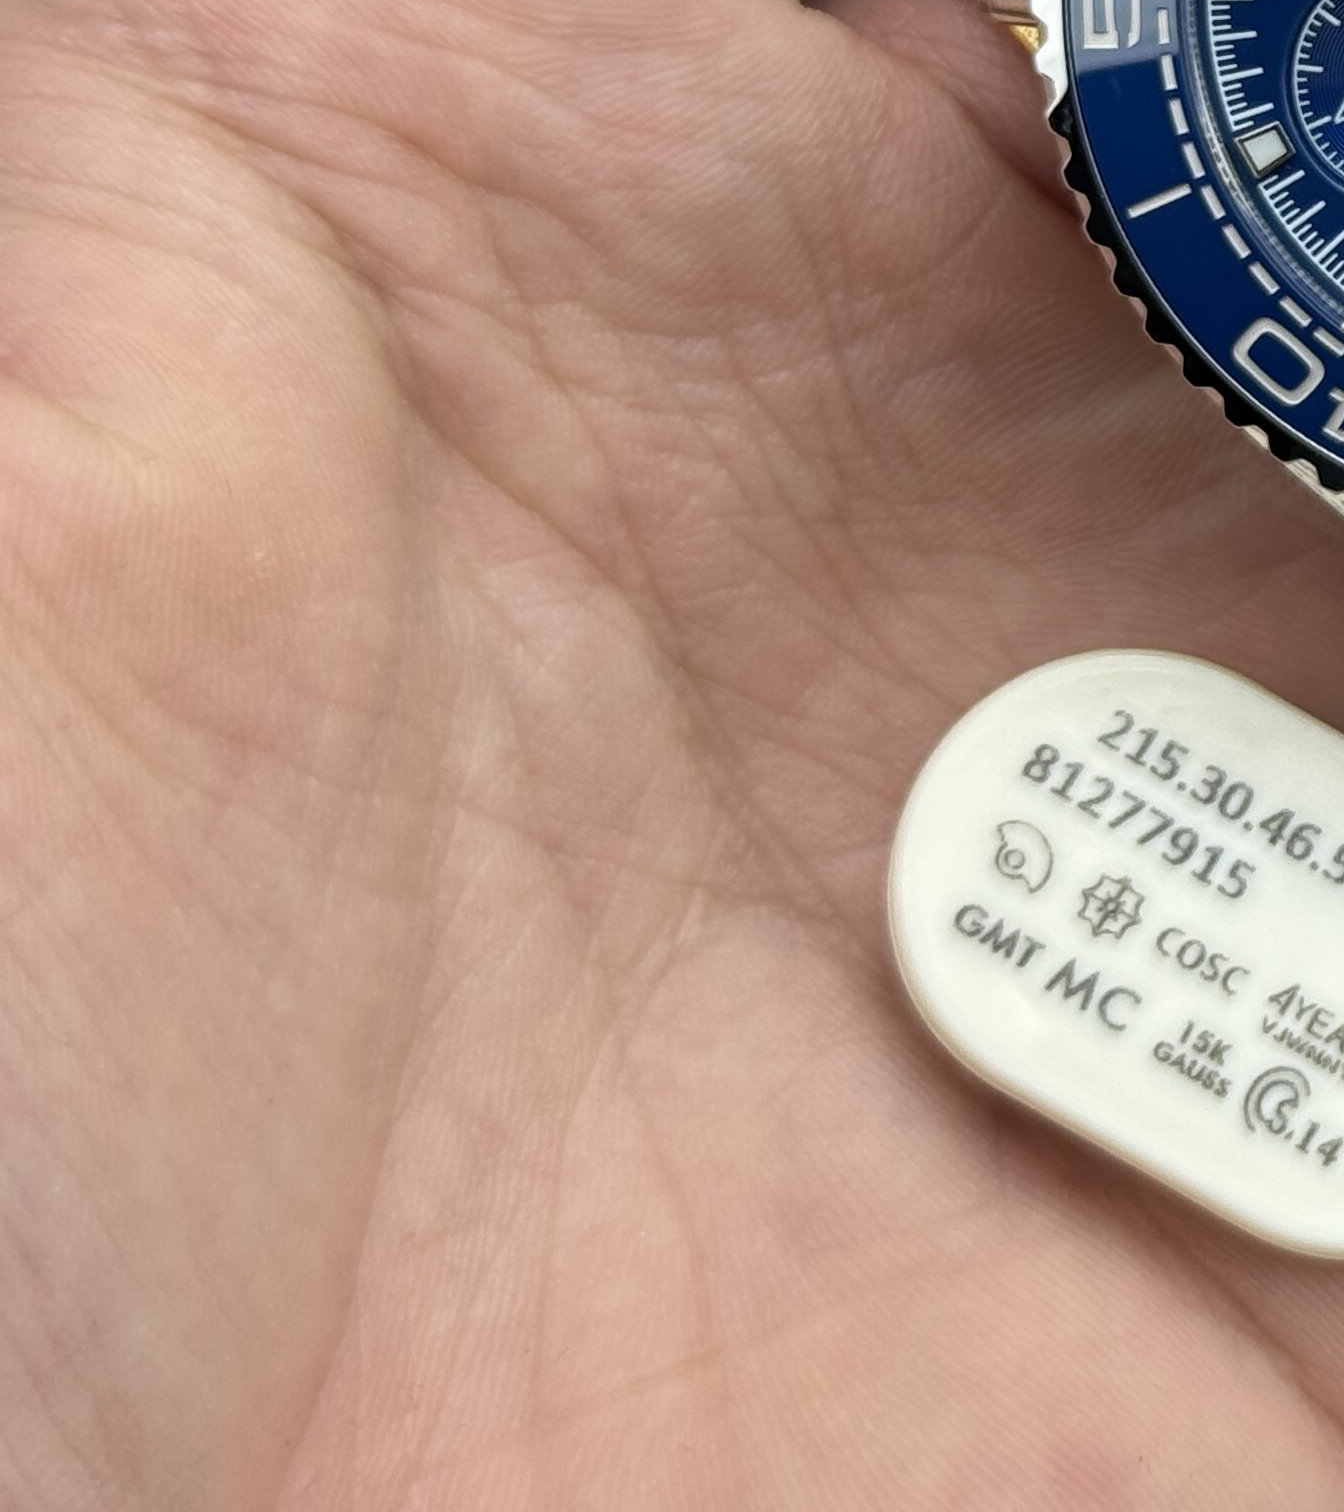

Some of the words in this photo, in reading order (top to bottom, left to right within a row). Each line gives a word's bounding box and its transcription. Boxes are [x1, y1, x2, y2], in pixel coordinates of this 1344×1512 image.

[1021, 741, 1257, 901] 81277915
[953, 902, 1048, 972] GMT
[1044, 956, 1143, 1034] MC
[1155, 925, 1252, 997] COSC
[1152, 1039, 1233, 1100] GAUSS
[1178, 1019, 1235, 1067] 15K
